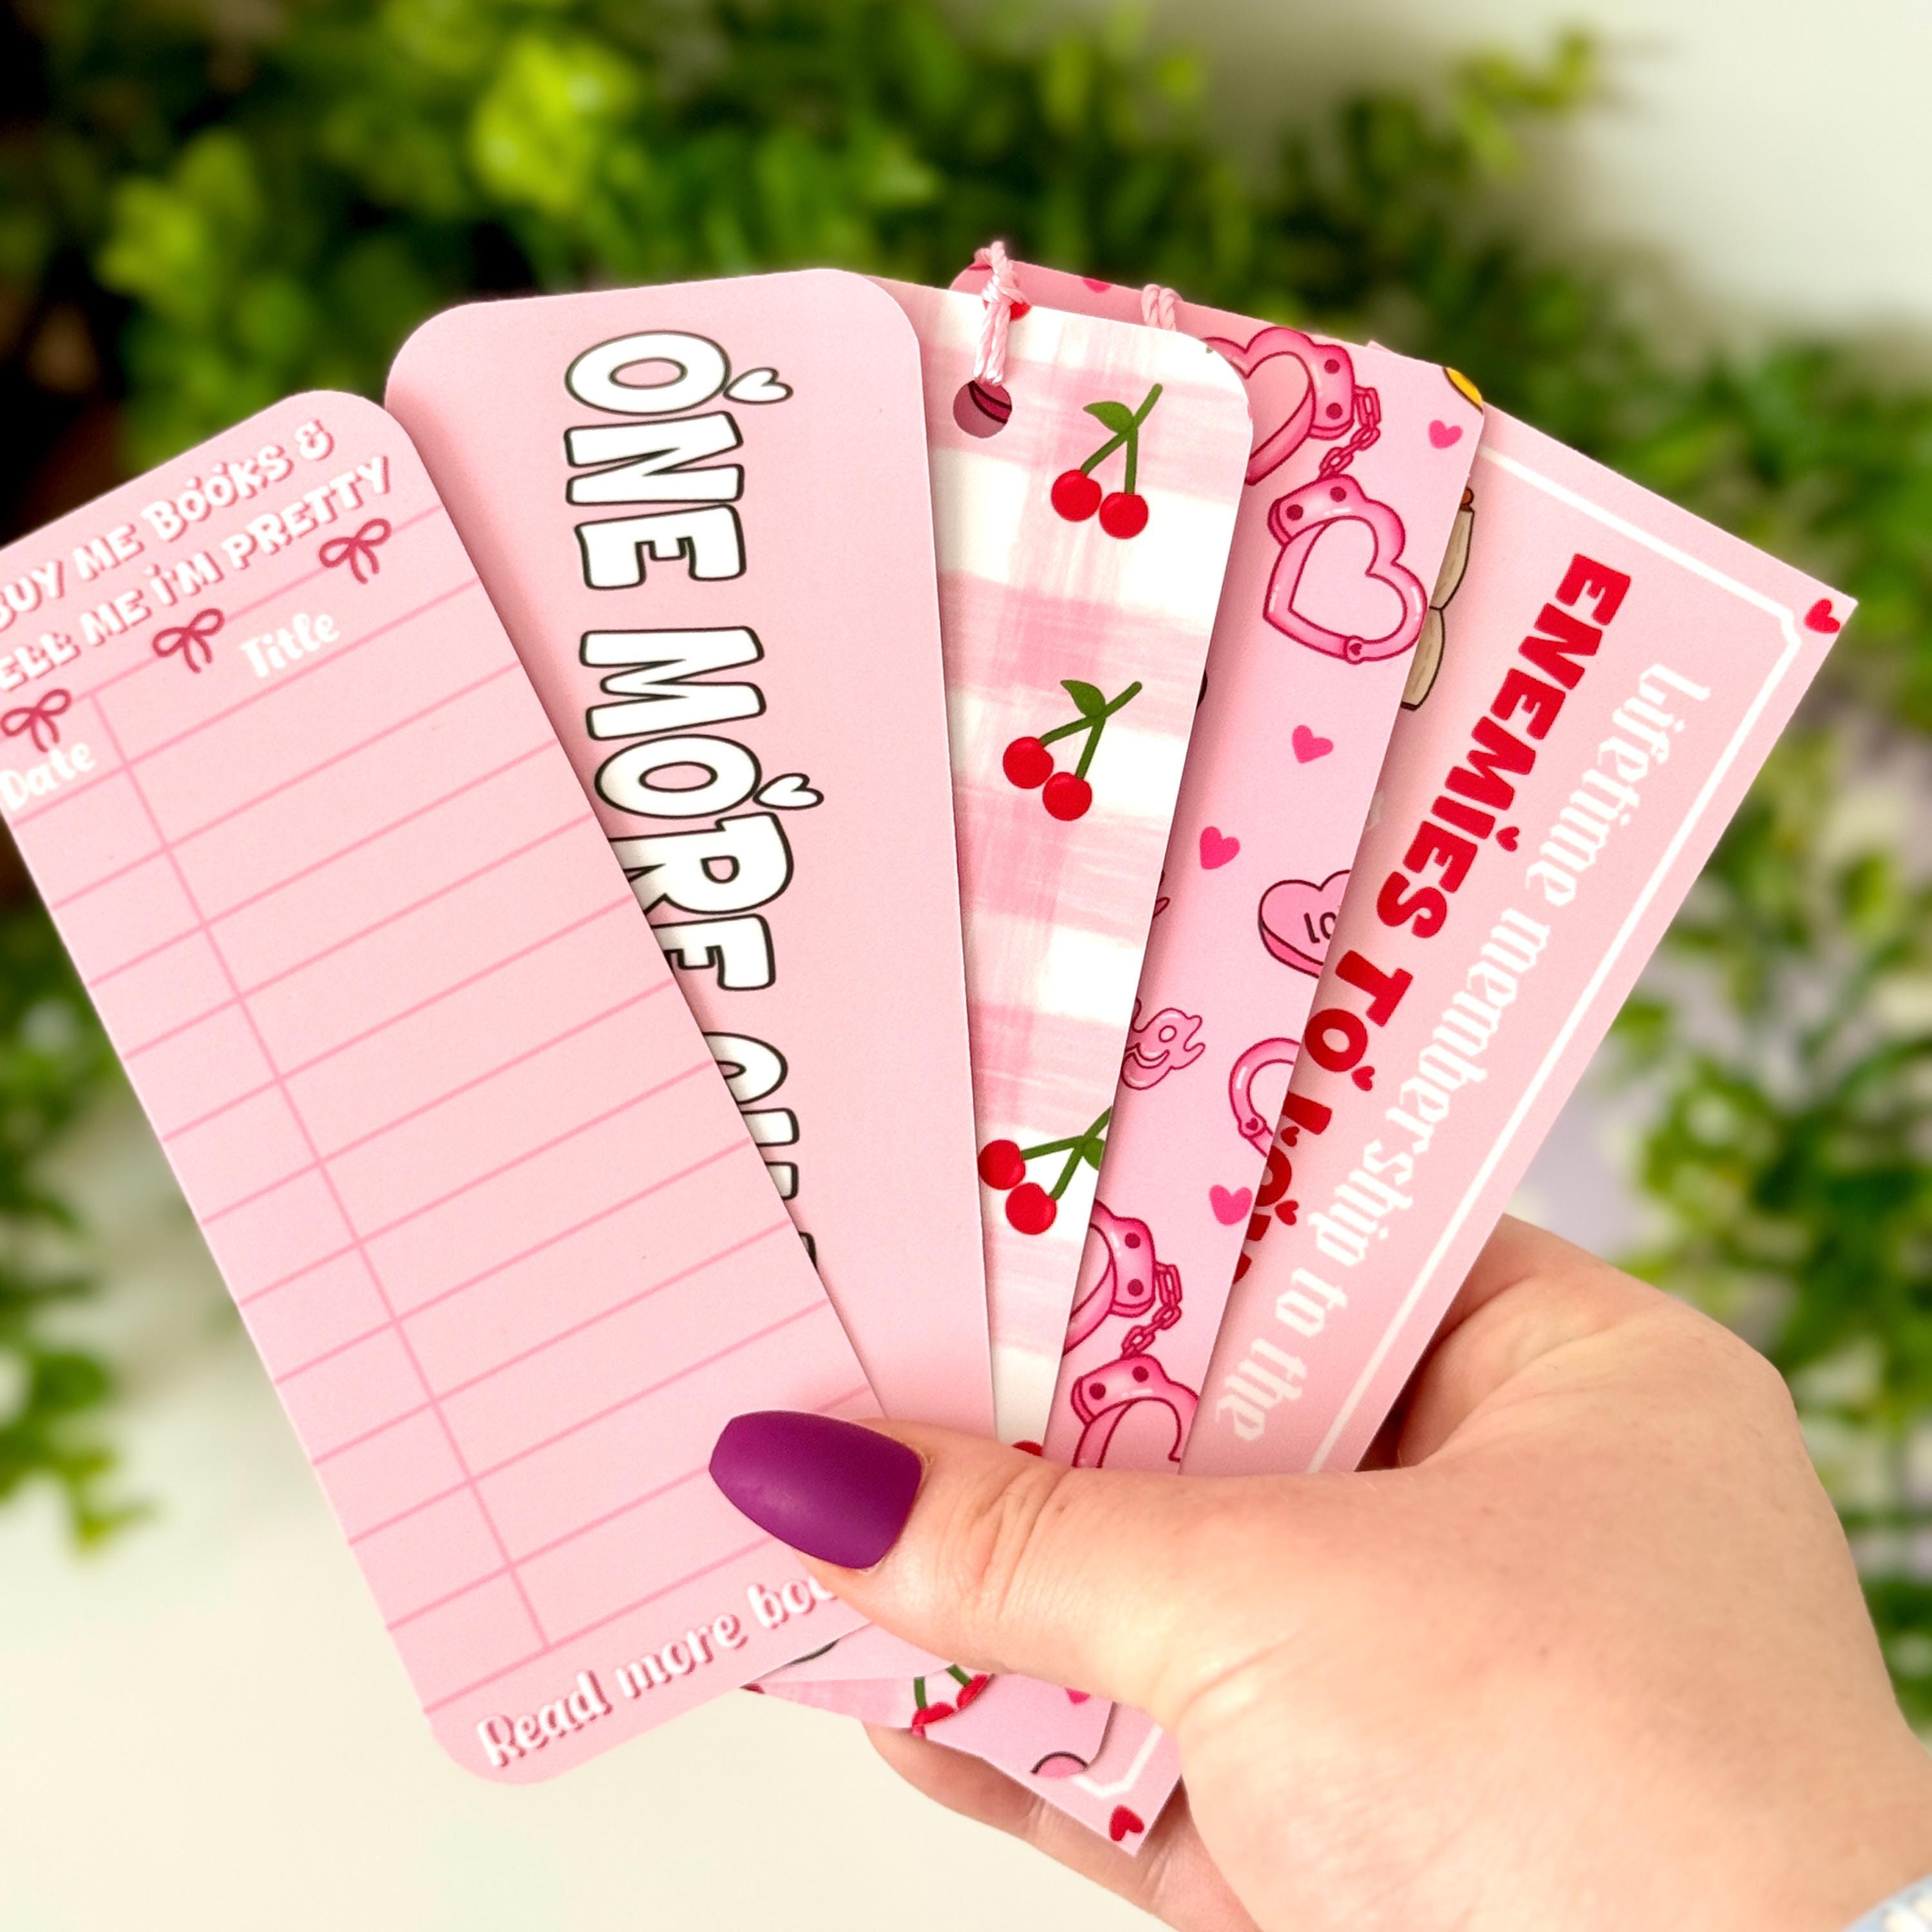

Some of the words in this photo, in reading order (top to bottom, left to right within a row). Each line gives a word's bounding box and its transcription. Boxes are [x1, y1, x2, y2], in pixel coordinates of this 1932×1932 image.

[72, 522, 145, 582] ME
[141, 446, 293, 542] BOOKS
[295, 419, 334, 461] &
[564, 330, 793, 590] ONE
[79, 590, 152, 647] ME
[222, 456, 389, 569] PRETTY
[240, 612, 341, 677] Title
[0, 743, 96, 811] Date
[1377, 553, 1631, 939] ENEMIES
[1526, 663, 1711, 905] Lifetime
[1304, 949, 1414, 1091] TO
[1307, 908, 1551, 1267] membership
[1276, 1267, 1349, 1336] to
[1215, 1338, 1307, 1441] the
[477, 1669, 614, 1767] Read
[616, 1612, 748, 1700] more
